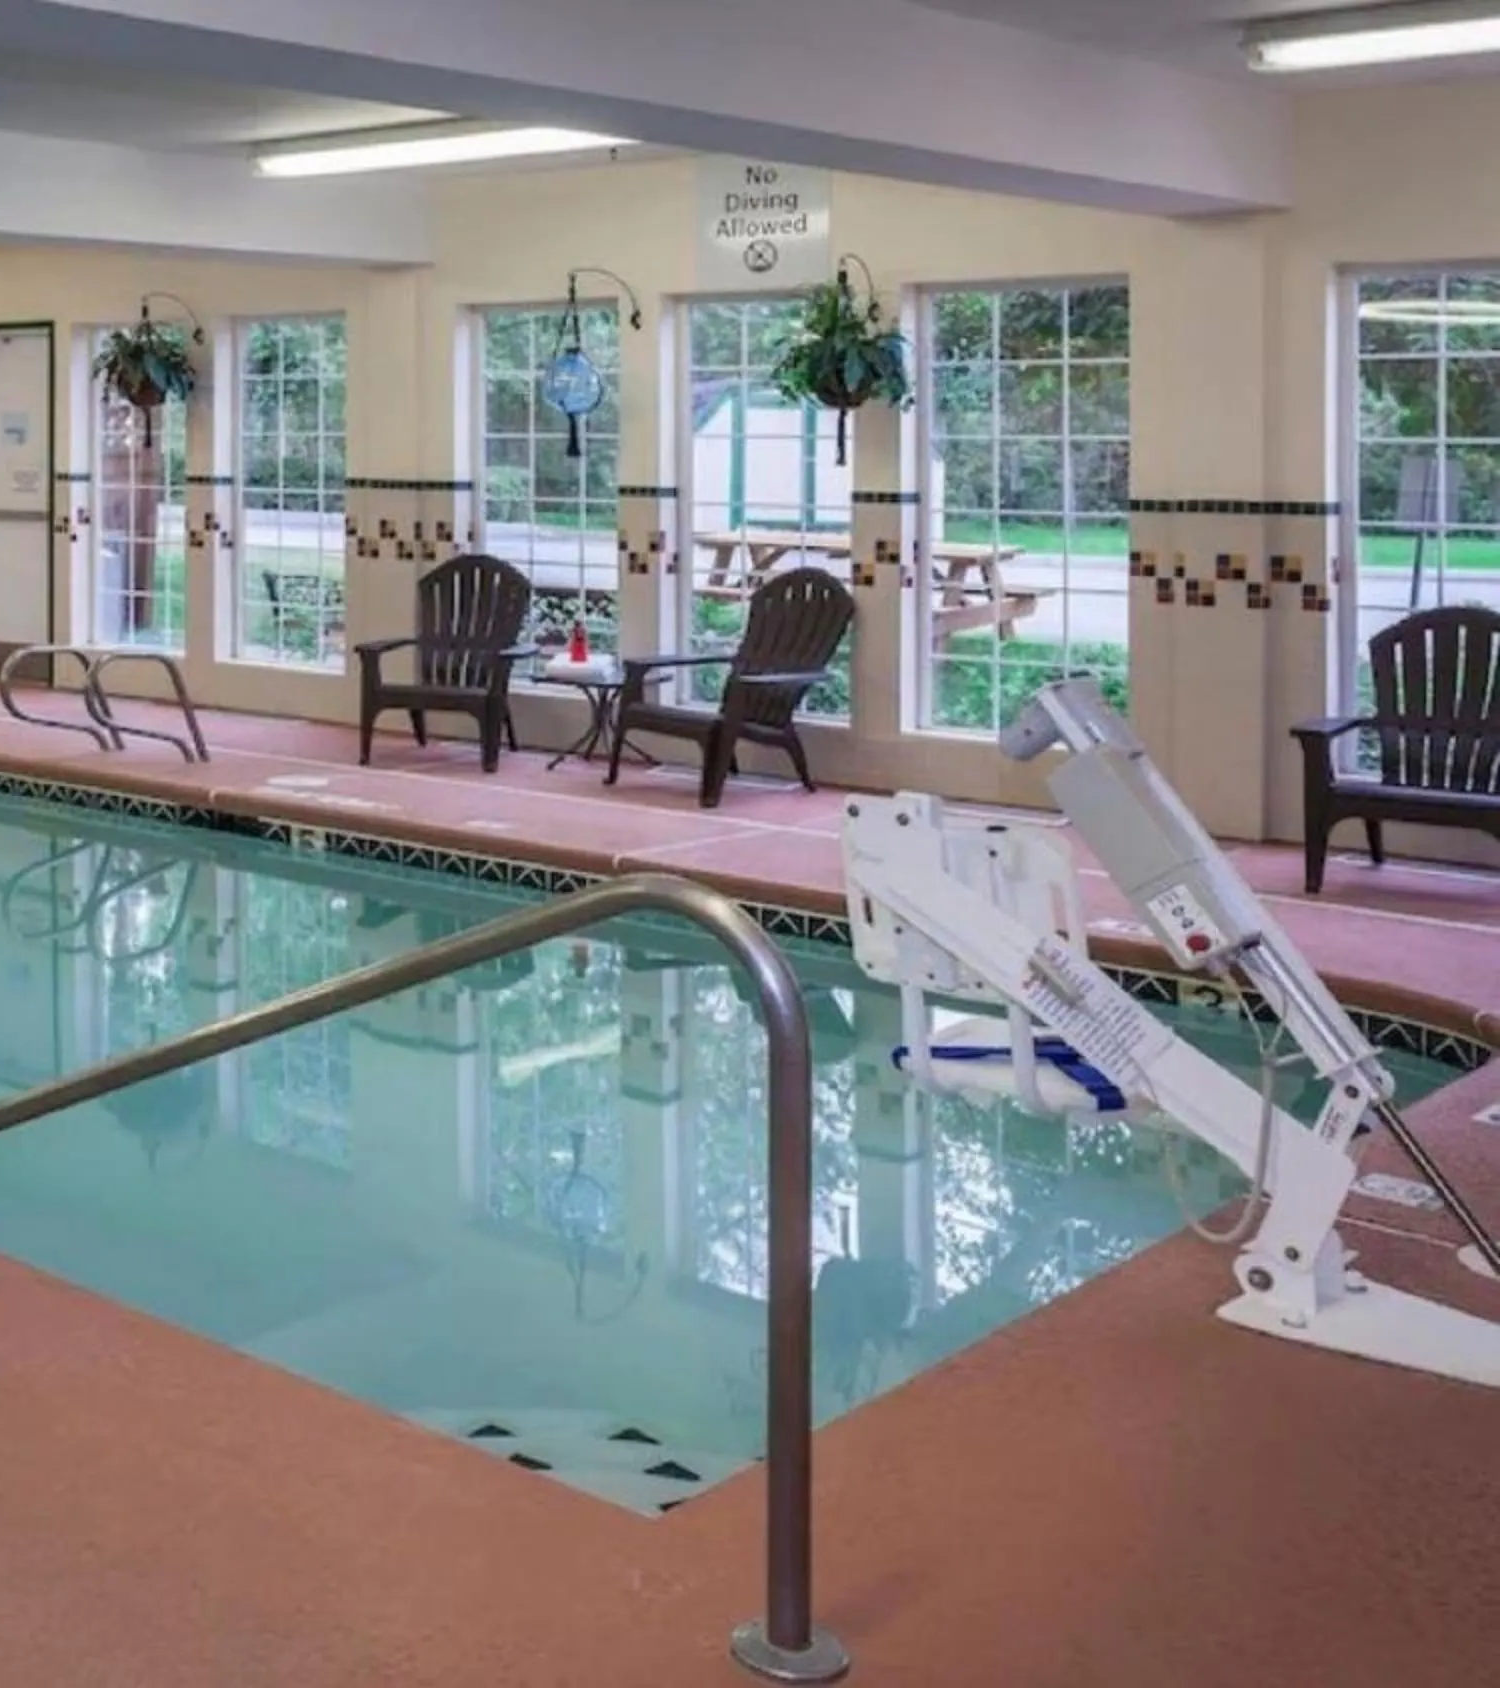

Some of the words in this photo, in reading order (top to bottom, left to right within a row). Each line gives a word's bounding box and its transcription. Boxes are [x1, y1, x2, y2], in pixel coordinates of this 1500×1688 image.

[745, 165, 779, 185] No
[724, 191, 799, 214] Diving
[715, 212, 808, 239] Allowed
